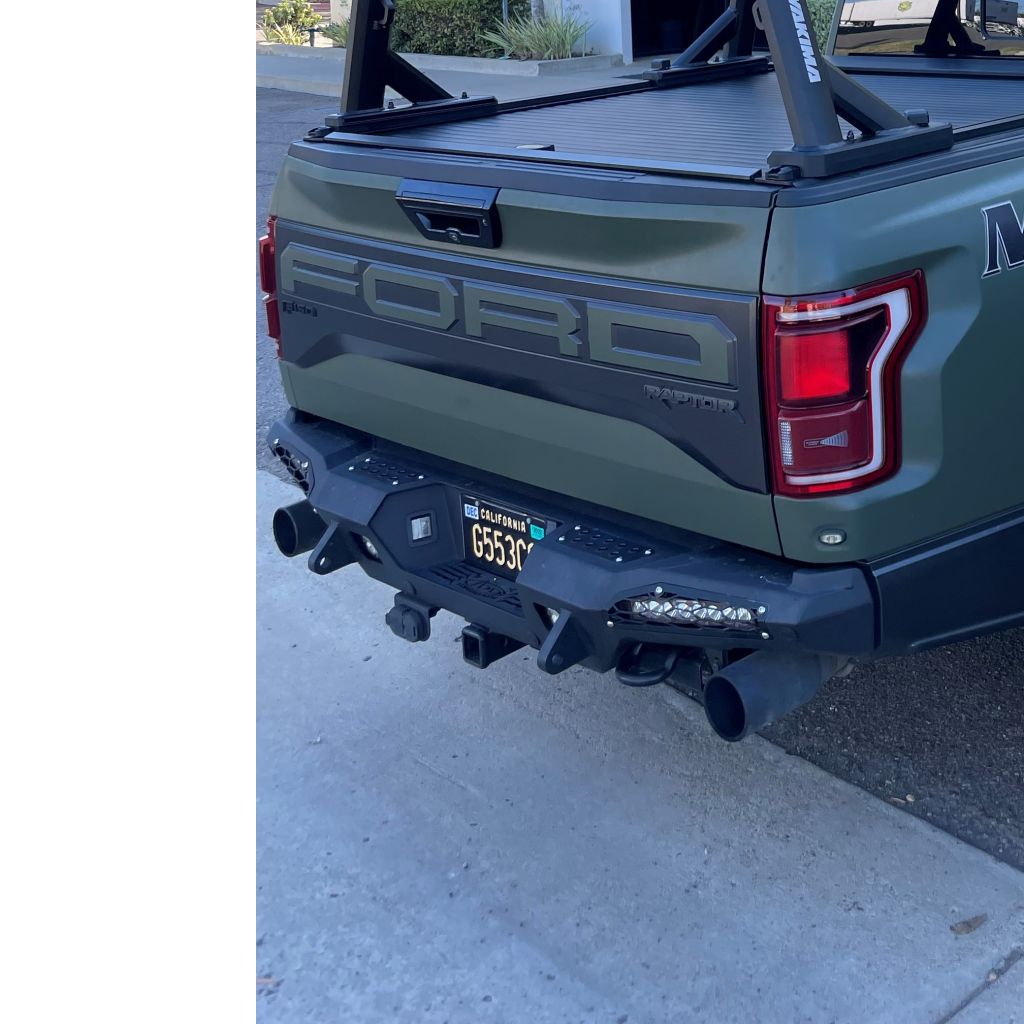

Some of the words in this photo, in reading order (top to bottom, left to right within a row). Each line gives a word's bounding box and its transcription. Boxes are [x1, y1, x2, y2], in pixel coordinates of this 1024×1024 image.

[280, 242, 737, 387] FORD
[643, 384, 745, 424] RAPTOR
[466, 505, 478, 517] DEC
[480, 508, 526, 533] CALIFORNIA
